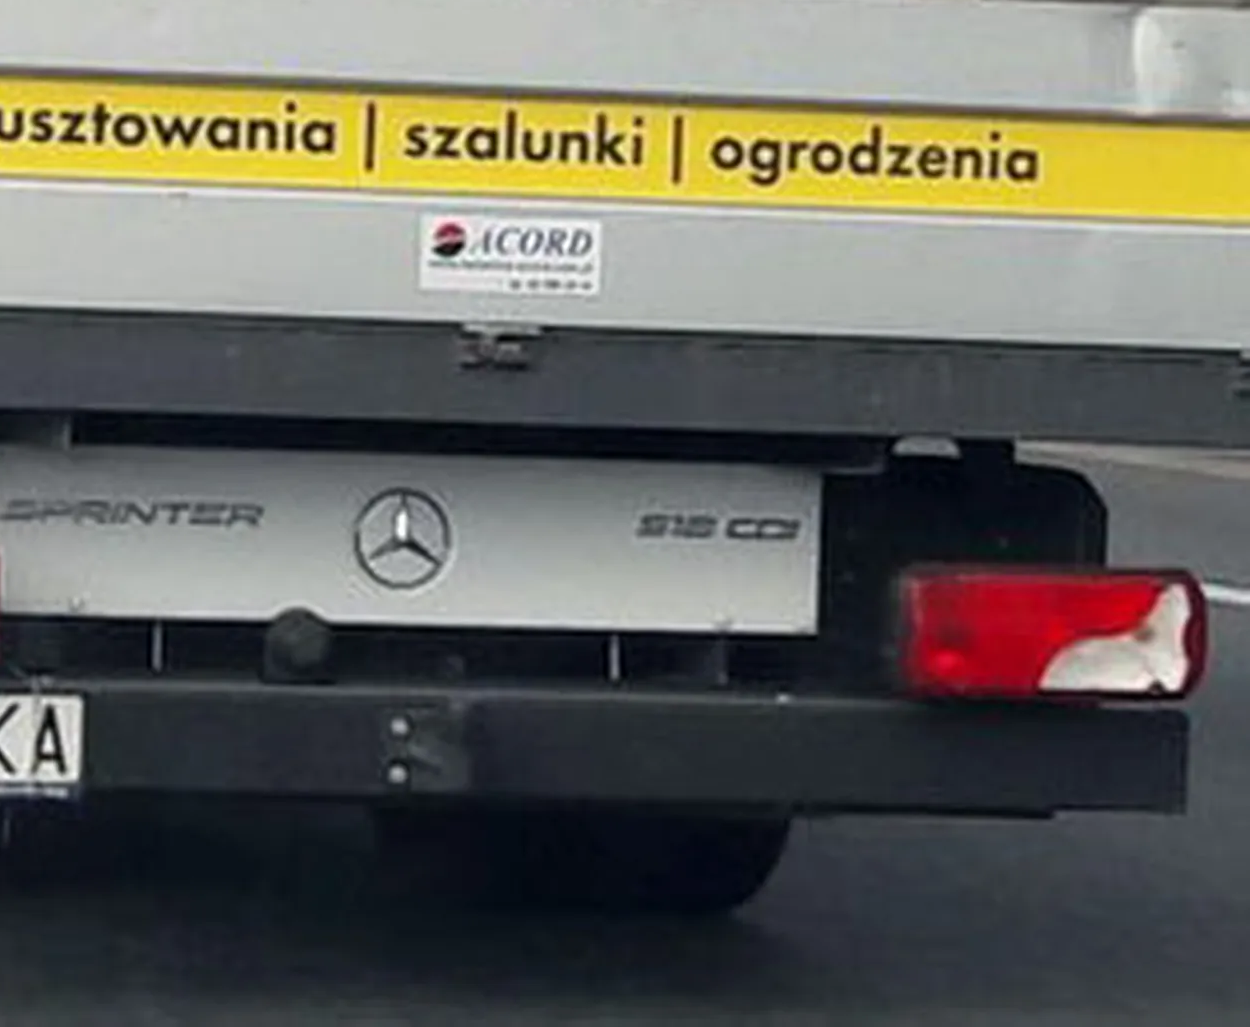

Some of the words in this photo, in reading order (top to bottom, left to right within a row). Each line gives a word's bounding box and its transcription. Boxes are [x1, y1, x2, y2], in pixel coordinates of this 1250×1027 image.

[403, 108, 645, 166] szalunki
[709, 123, 1040, 186] ogrodzenia
[468, 227, 594, 257] ACORD
